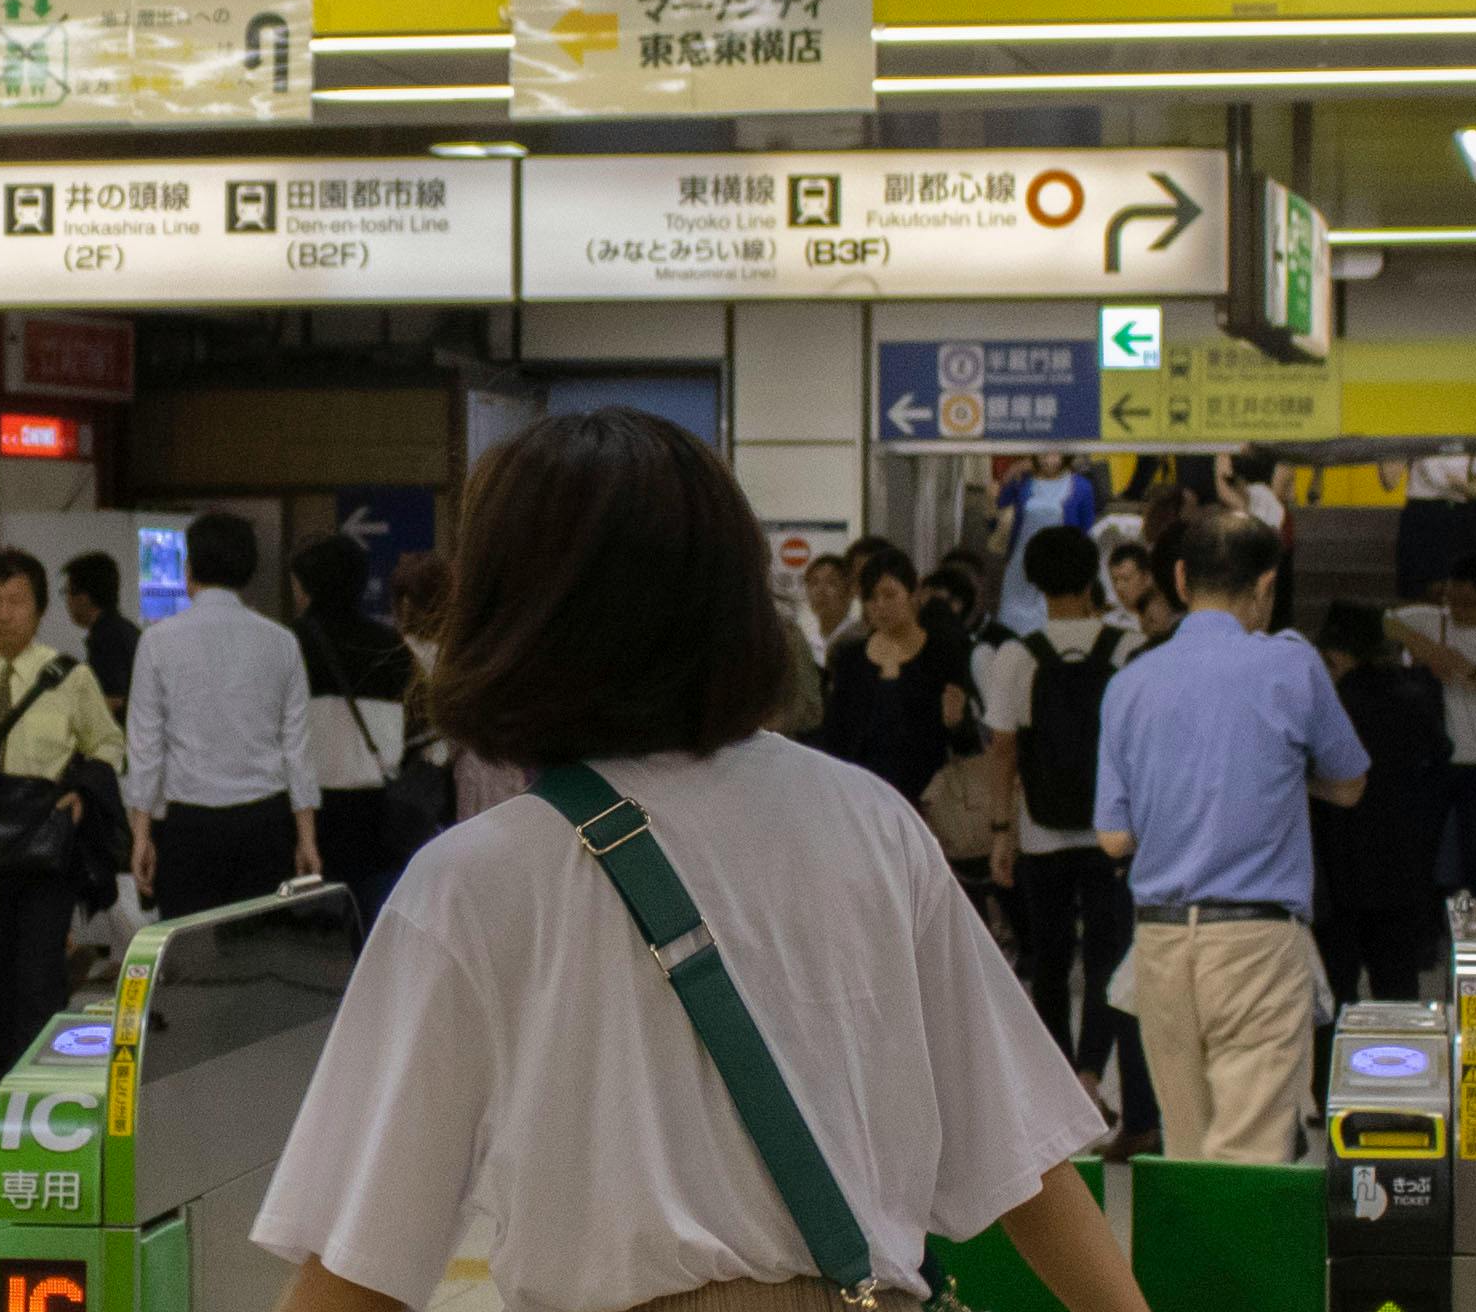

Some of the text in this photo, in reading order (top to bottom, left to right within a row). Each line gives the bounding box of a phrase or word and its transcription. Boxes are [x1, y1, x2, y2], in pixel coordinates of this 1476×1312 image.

[639, 29, 823, 68] 東急東横店
[65, 182, 189, 210] 井の頭線
[287, 180, 447, 209] 田園都市線
[679, 175, 775, 205] 東横線
[884, 173, 1016, 205] 副都心線
[64, 220, 201, 235] Inokashira Line
[411, 217, 450, 233] Line
[736, 212, 777, 229] Line
[866, 210, 1017, 229] Fukutoshin Line
[64, 245, 125, 271] (2F)
[286, 242, 369, 270] (B2F)
[805, 236, 890, 266] (B3F)
[0, 1091, 98, 1152] IC
[1, 1170, 82, 1212] 専用
[1392, 1176, 1432, 1194] きっぷ
[1393, 1194, 1432, 1207] TICKET
